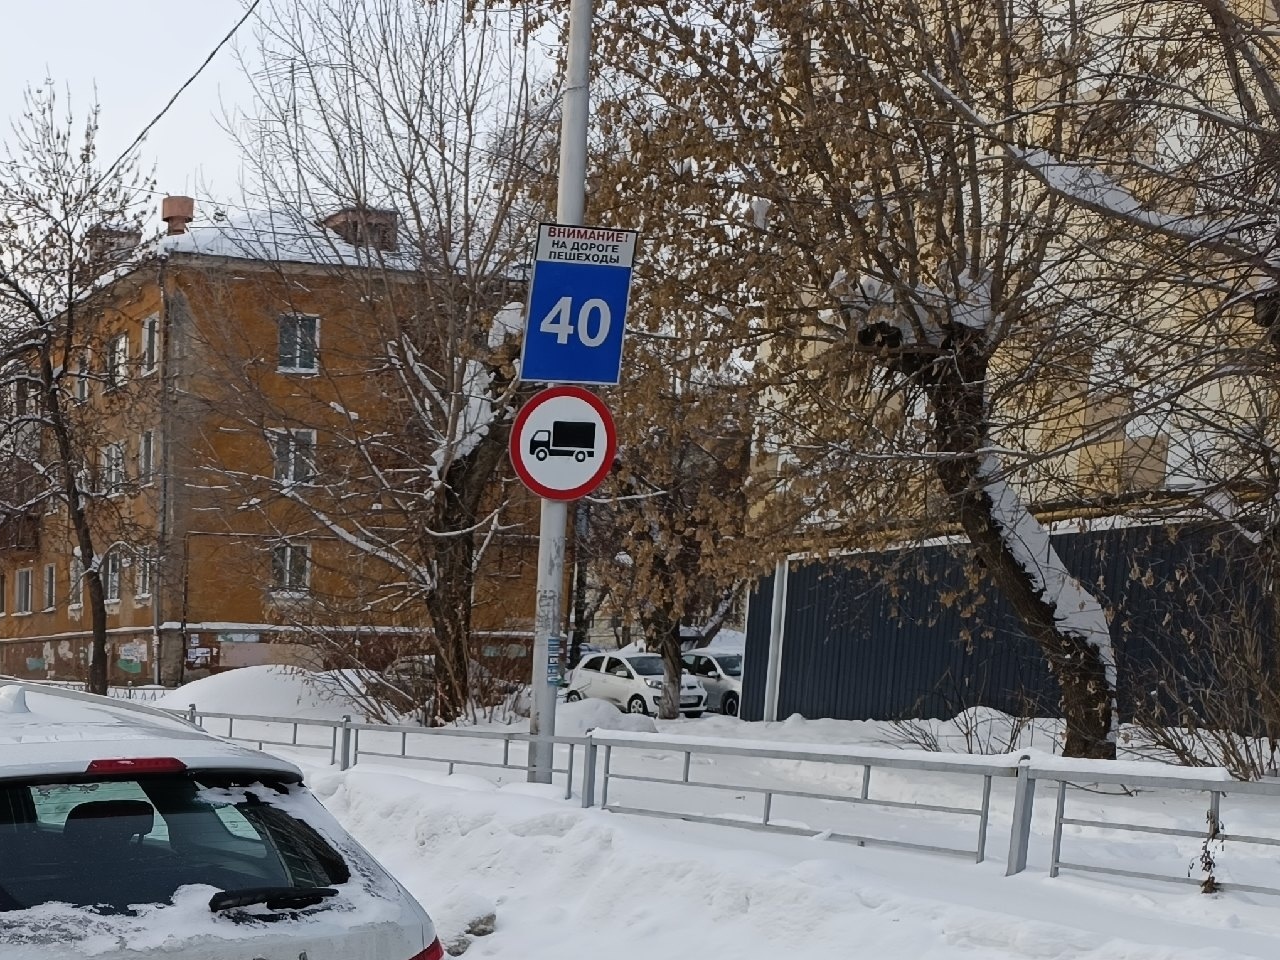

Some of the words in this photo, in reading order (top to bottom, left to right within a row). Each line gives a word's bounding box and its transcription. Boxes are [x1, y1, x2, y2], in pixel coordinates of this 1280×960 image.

[547, 226, 629, 243] ВНИМАНИЕ!
[551, 239, 567, 249] НА
[571, 241, 620, 253] ДОРОГЕ
[548, 251, 620, 264] ПЕШЕХОДЫ
[539, 296, 612, 347] 40
